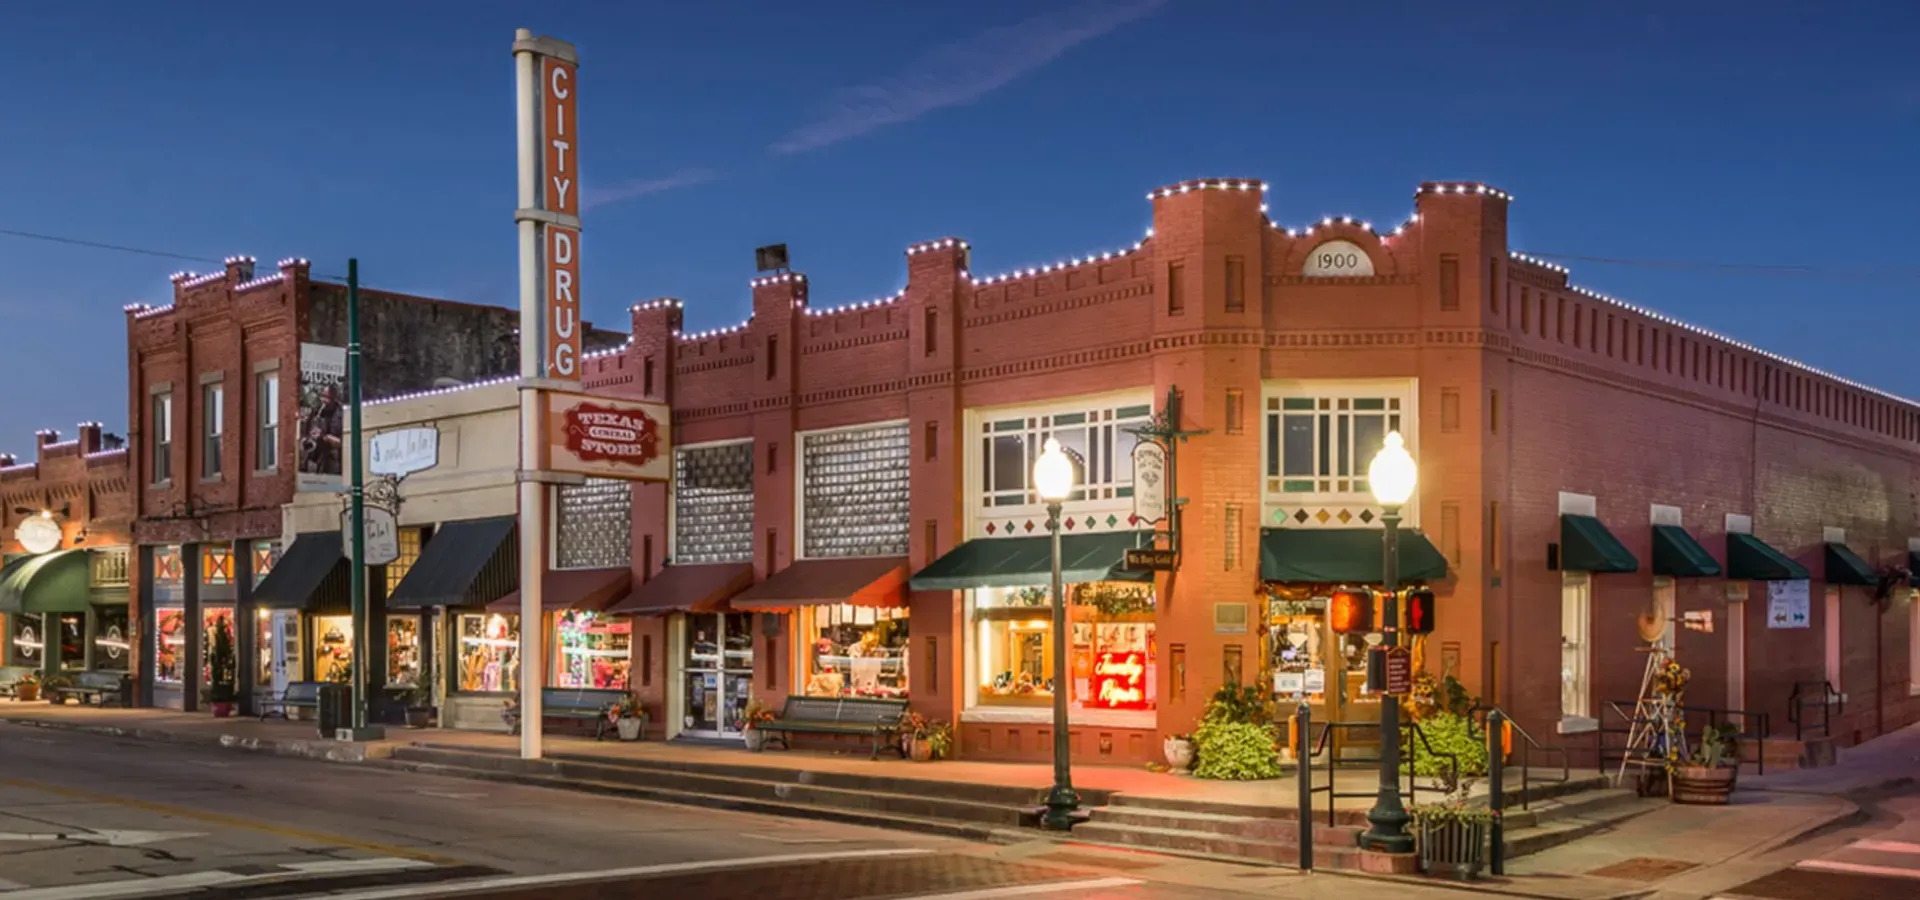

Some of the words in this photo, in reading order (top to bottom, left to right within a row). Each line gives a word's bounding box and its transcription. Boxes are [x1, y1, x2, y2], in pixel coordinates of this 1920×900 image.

[552, 67, 570, 209] CITY
[1318, 253, 1358, 269] 1900
[555, 232, 574, 376] DRUG
[302, 371, 345, 386] MUSIC
[578, 412, 645, 430] TEXAS
[591, 429, 633, 439] GENERAL
[581, 439, 642, 455] STORE
